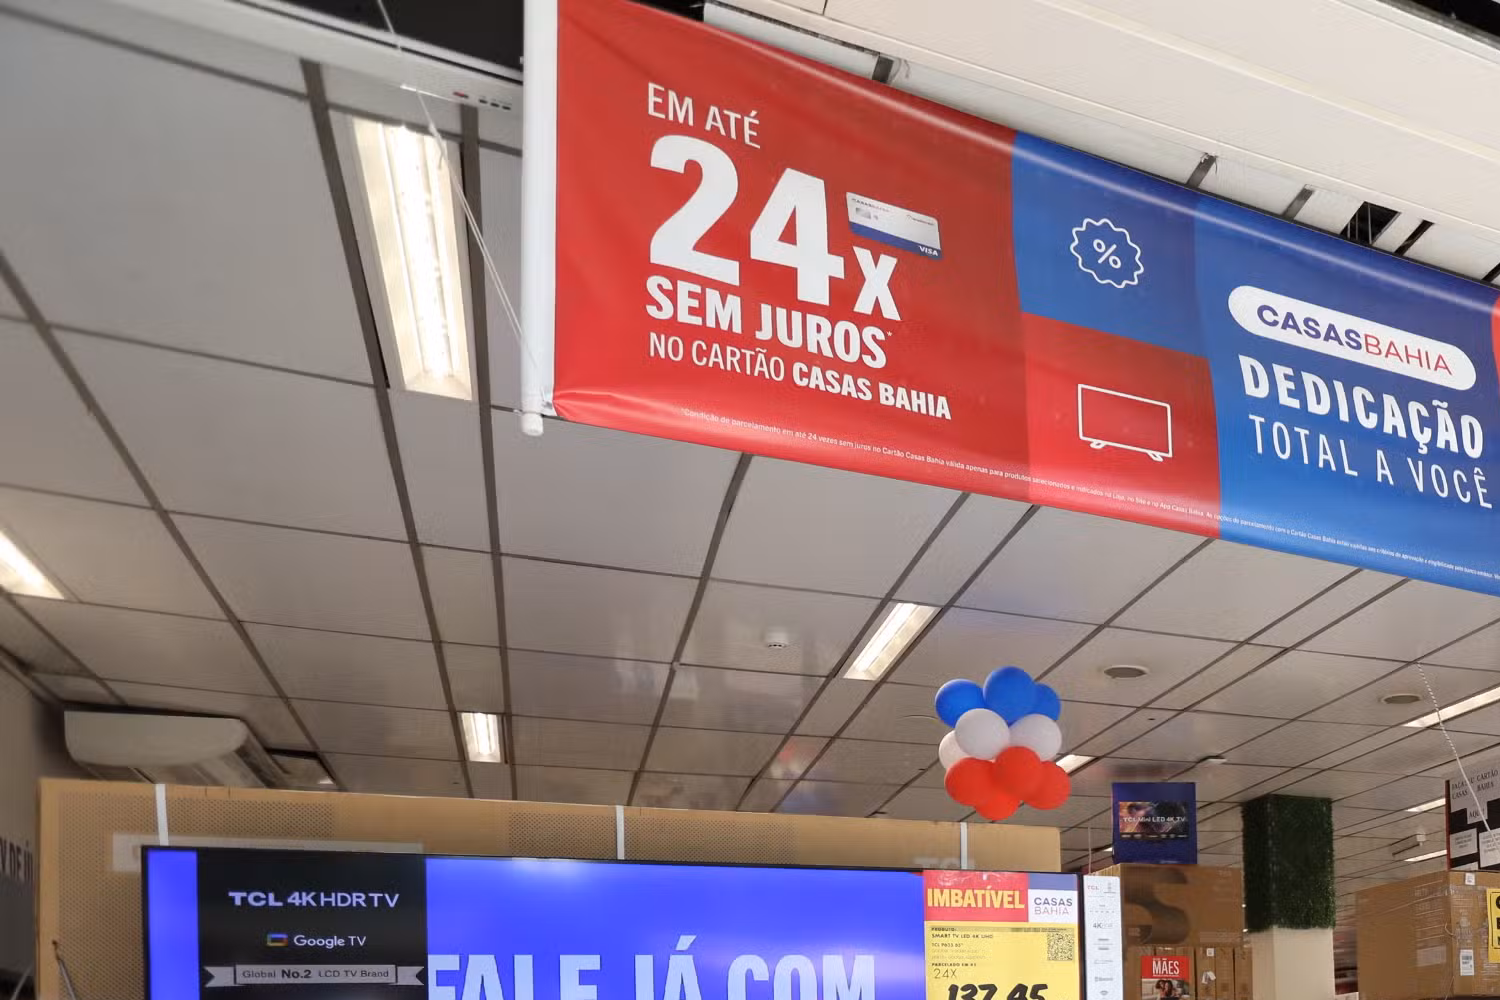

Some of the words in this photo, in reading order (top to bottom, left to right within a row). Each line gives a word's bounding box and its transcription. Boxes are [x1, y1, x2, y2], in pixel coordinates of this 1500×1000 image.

[648, 82, 694, 126] EM
[705, 105, 761, 149] ATÉ
[919, 245, 938, 257] VISA
[646, 275, 742, 334] SEM
[1256, 304, 1453, 375] CASASBAHIA
[649, 331, 684, 362] NO
[691, 339, 785, 382] CARTÃO
[792, 361, 873, 401] CASAS
[878, 382, 952, 420] BAHIA
[1238, 354, 1484, 459] DEDICAÇÃO
[731, 418, 781, 435] parcelamento
[807, 432, 818, 441] 24
[818, 435, 838, 446] vezes
[838, 438, 854, 448] sem
[854, 441, 872, 453] juros
[882, 446, 905, 459] Cartão
[905, 450, 926, 463] Casas
[926, 454, 945, 466] Bahia
[965, 463, 989, 475] apenas
[1248, 414, 1358, 477] TOTAL
[1376, 449, 1394, 485] A
[1407, 457, 1493, 509] VOCÊ
[228, 891, 283, 907] TCL
[368, 893, 400, 907] TV
[927, 887, 1025, 909] IMBATÍVEL
[1034, 897, 1073, 906] CASAS
[1034, 906, 1070, 915] BAHIA
[293, 934, 346, 949] Google
[348, 936, 367, 946] TV
[242, 969, 276, 978] Global
[281, 969, 312, 979] No.2
[318, 970, 341, 978] LCD
[344, 970, 358, 978] TV
[360, 970, 389, 978] Brand
[933, 968, 957, 979] 24X
[1153, 958, 1180, 975] MÃES
